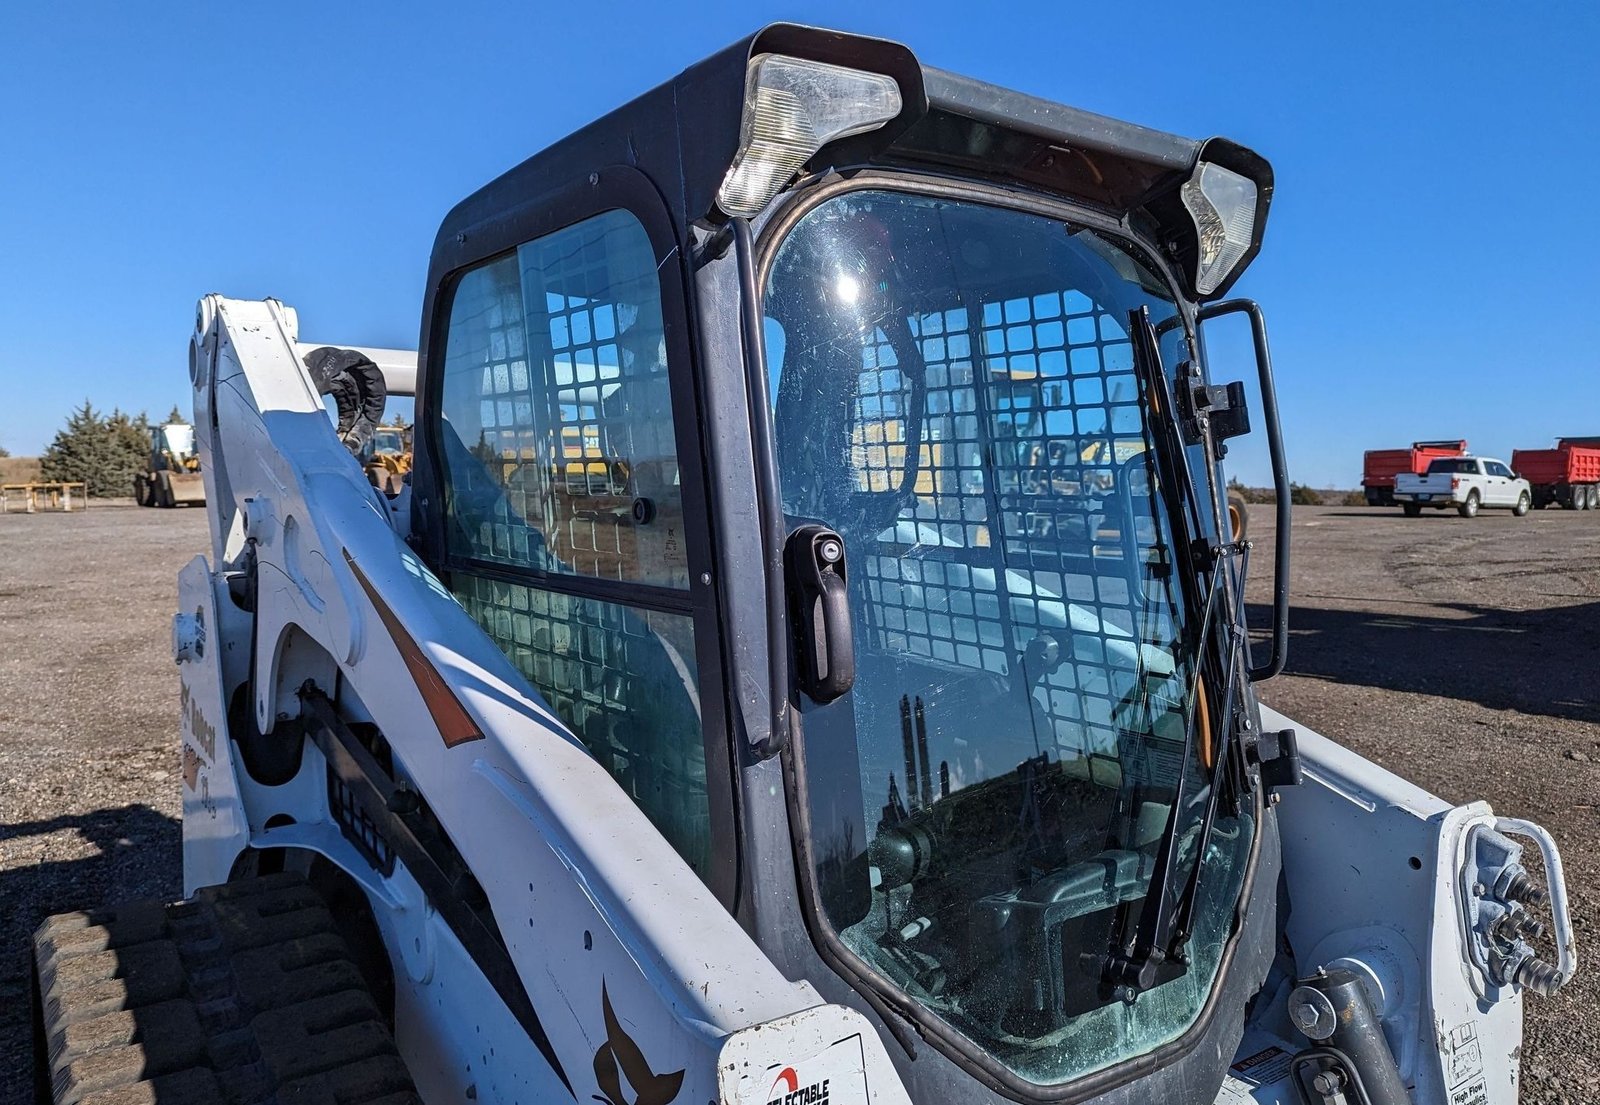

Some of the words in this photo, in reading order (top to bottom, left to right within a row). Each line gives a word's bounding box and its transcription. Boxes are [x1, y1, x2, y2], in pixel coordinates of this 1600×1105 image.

[767, 1079, 829, 1105] ECTABLE
[1454, 1091, 1468, 1104] High
[1469, 1083, 1483, 1096] Flow
